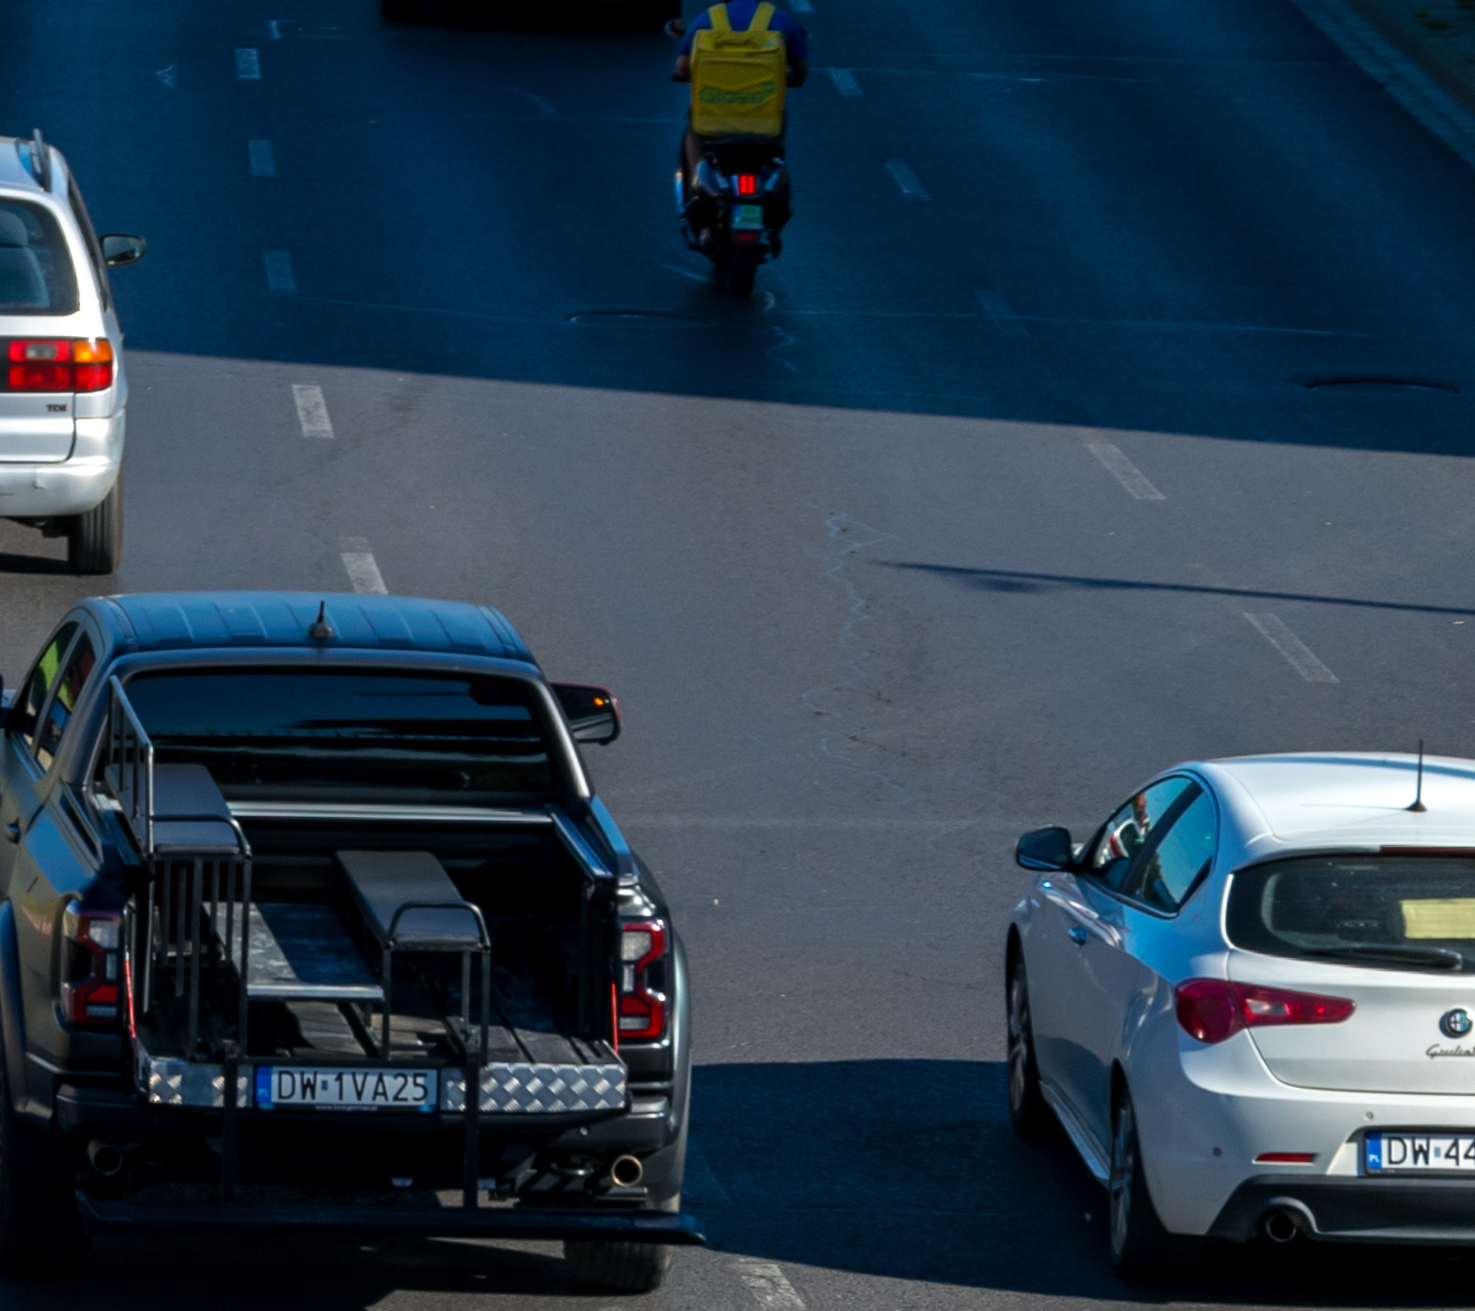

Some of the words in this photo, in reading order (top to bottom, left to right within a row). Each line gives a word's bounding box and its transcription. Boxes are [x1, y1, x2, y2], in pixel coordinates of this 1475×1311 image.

[277, 1070, 318, 1101] DW
[334, 1071, 429, 1102] 1VA25
[1387, 1136, 1431, 1166] DW
